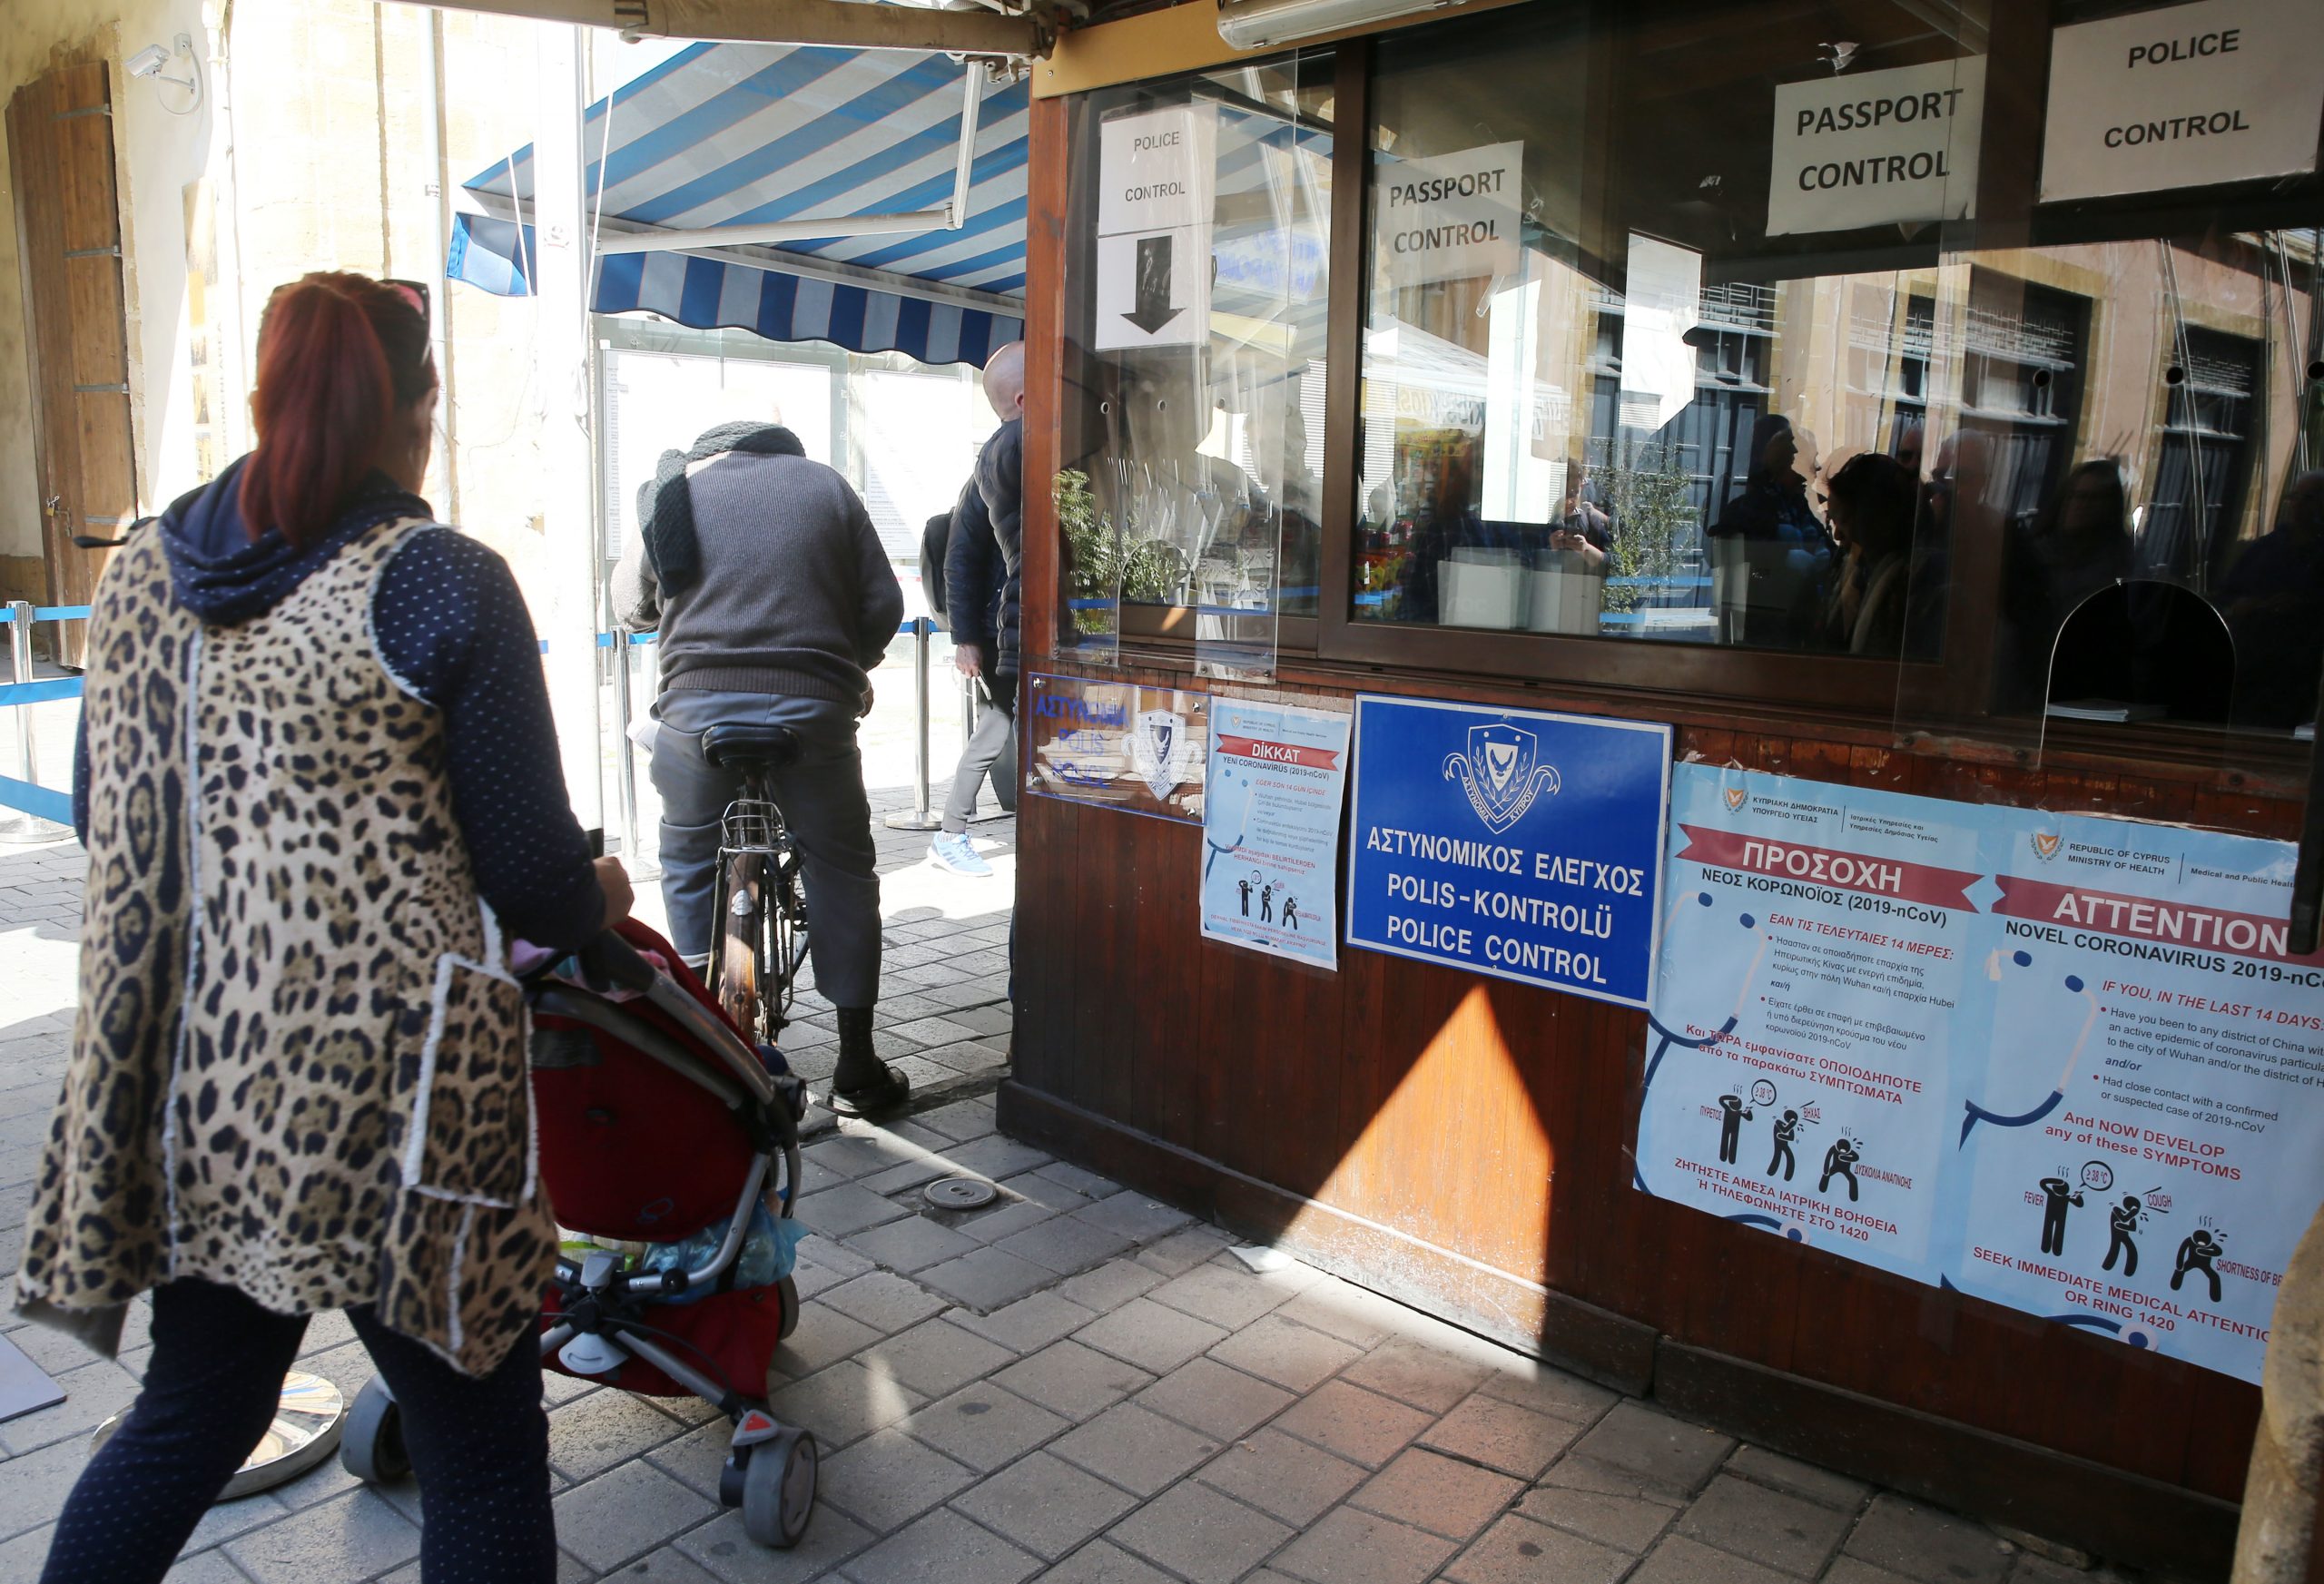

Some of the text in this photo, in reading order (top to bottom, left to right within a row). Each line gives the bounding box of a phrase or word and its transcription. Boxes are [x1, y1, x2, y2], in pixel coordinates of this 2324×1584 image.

[2129, 29, 2240, 68] POLICE
[1797, 88, 1963, 135] PASSPORT
[2104, 110, 2250, 148] CONTROL
[1134, 131, 1180, 152] POLICE
[1390, 168, 1505, 208] PASSPORT
[1798, 151, 1950, 192] CONTROL
[1125, 182, 1186, 202] CONTROL
[1394, 221, 1499, 254] CONTROL
[1224, 756, 1238, 764] YENİ
[1290, 767, 1329, 781] (2019-nCoV)
[1252, 742, 1300, 762] DİKKAT
[1462, 776, 1533, 822] ΑΣΤΥΝΟΜΙΑ ΚΥΠΡΟΥ
[1752, 807, 1817, 822] ΥΠΟΥΡΓΕΙΟ ΥΓΕΙΑΣ
[1753, 797, 1838, 816] ΚΥΠΡΙΑΚΗ ΔΗΜΟΚΡΑΤΙΑ
[1367, 827, 1523, 874] ΑΣΤΥΝΟΜΙΚΟΣ
[1535, 853, 1643, 896] ΕΛΕΓΧΟΣ
[1742, 841, 1902, 892] ΠΡΟΣΟΧΗ
[2068, 855, 2111, 867] MINISTRY
[2130, 863, 2164, 875] HEALTH
[2070, 843, 2114, 856] REPUBLIC
[2133, 852, 2170, 863] CYPRUS
[2191, 868, 2222, 878] Medical
[2242, 876, 2268, 884] Public
[1702, 868, 1947, 929] ΝΕΟΣ ΚΟΡΩΝΟΪΟΣ (2019-nCoV)
[1769, 914, 1954, 959] ΕΑΝ ΤΙΣ ΤΕΛΕΥΤΑΙΕΣ 14 ΜΕΡΕΣ:
[2053, 893, 2289, 957] ATTENTION
[1388, 916, 1606, 984] POLICE CONTROL
[1812, 945, 1822, 953] σε
[1876, 959, 1908, 973] επαρχία
[1911, 965, 1925, 976] της
[1823, 959, 1845, 973] Κίνας
[1858, 968, 1885, 981] ενεργή
[2005, 921, 2324, 989] NOVEL CORONAVIRUS 2019-nC
[1771, 980, 1790, 991] και/ή
[1773, 963, 1798, 976] κυρίως
[1801, 969, 1817, 979] στην
[1821, 972, 1840, 985] πόλη
[1843, 977, 1871, 990] Wuhan
[1894, 989, 1926, 1003] επαρχία
[1929, 994, 1955, 1008] Hubei
[2102, 980, 2116, 991] IF
[2121, 984, 2152, 1002] YOU,
[2157, 990, 2172, 1003] IN
[2178, 995, 2207, 1009] THE
[2210, 1000, 2251, 1018] LAST
[2256, 1008, 2272, 1020] 14
[1773, 1013, 1788, 1022] υπό
[1872, 1037, 1886, 1046] του
[1888, 1038, 1906, 1050] νέου
[1827, 1012, 1852, 1024] επαφή
[2111, 1008, 2304, 1053] Have you been to any district of China
[1686, 1024, 1922, 1093] Και ΤΩΡΑ εμφανίσατε ΟΠΟΙΟΔΗΠΟΤΕ
[1808, 1032, 1851, 1049] 2019-nCoV
[2109, 1023, 2278, 1063] an active epidemic of coronavirus
[1699, 1044, 1903, 1104] από τα παρακάτω ΣΥΜΠΤΩΜΑΤΑ
[2105, 1057, 2142, 1072] and/or
[2107, 1037, 2315, 1086] to the city of Wuhan and/or the district of
[1803, 1107, 1821, 1119] ΒΗΧΑΣ
[2101, 1091, 2265, 1134] or suspected case of 2019-nCoV
[2102, 1076, 2279, 1122] Had close contact with confirmed
[2045, 1127, 2241, 1180] any of these SYMPTOMS
[2063, 1111, 2225, 1157] And NOW DEVELOP
[1675, 1157, 1897, 1235] ΖΗΤΗΣΤΕ ΑΜΕΣΑ ΙΑΤΡΙΚΗ ΒΟΗΘΕΙΑ
[1712, 1184, 1869, 1241] ΤΗΛΕΦΩΝΗΣΤΕ ΣΤΟ 1420
[2024, 1191, 2043, 1207] FEVER
[2147, 1194, 2172, 1208] COUGH
[1974, 1246, 2013, 1268] SEEK
[2017, 1260, 2102, 1294] IMMEDIATE
[2108, 1286, 2182, 1317] MEDICAL
[2217, 1259, 2271, 1284] SHORTNESS OF
[2065, 1291, 2175, 1332] OR RING 1420
